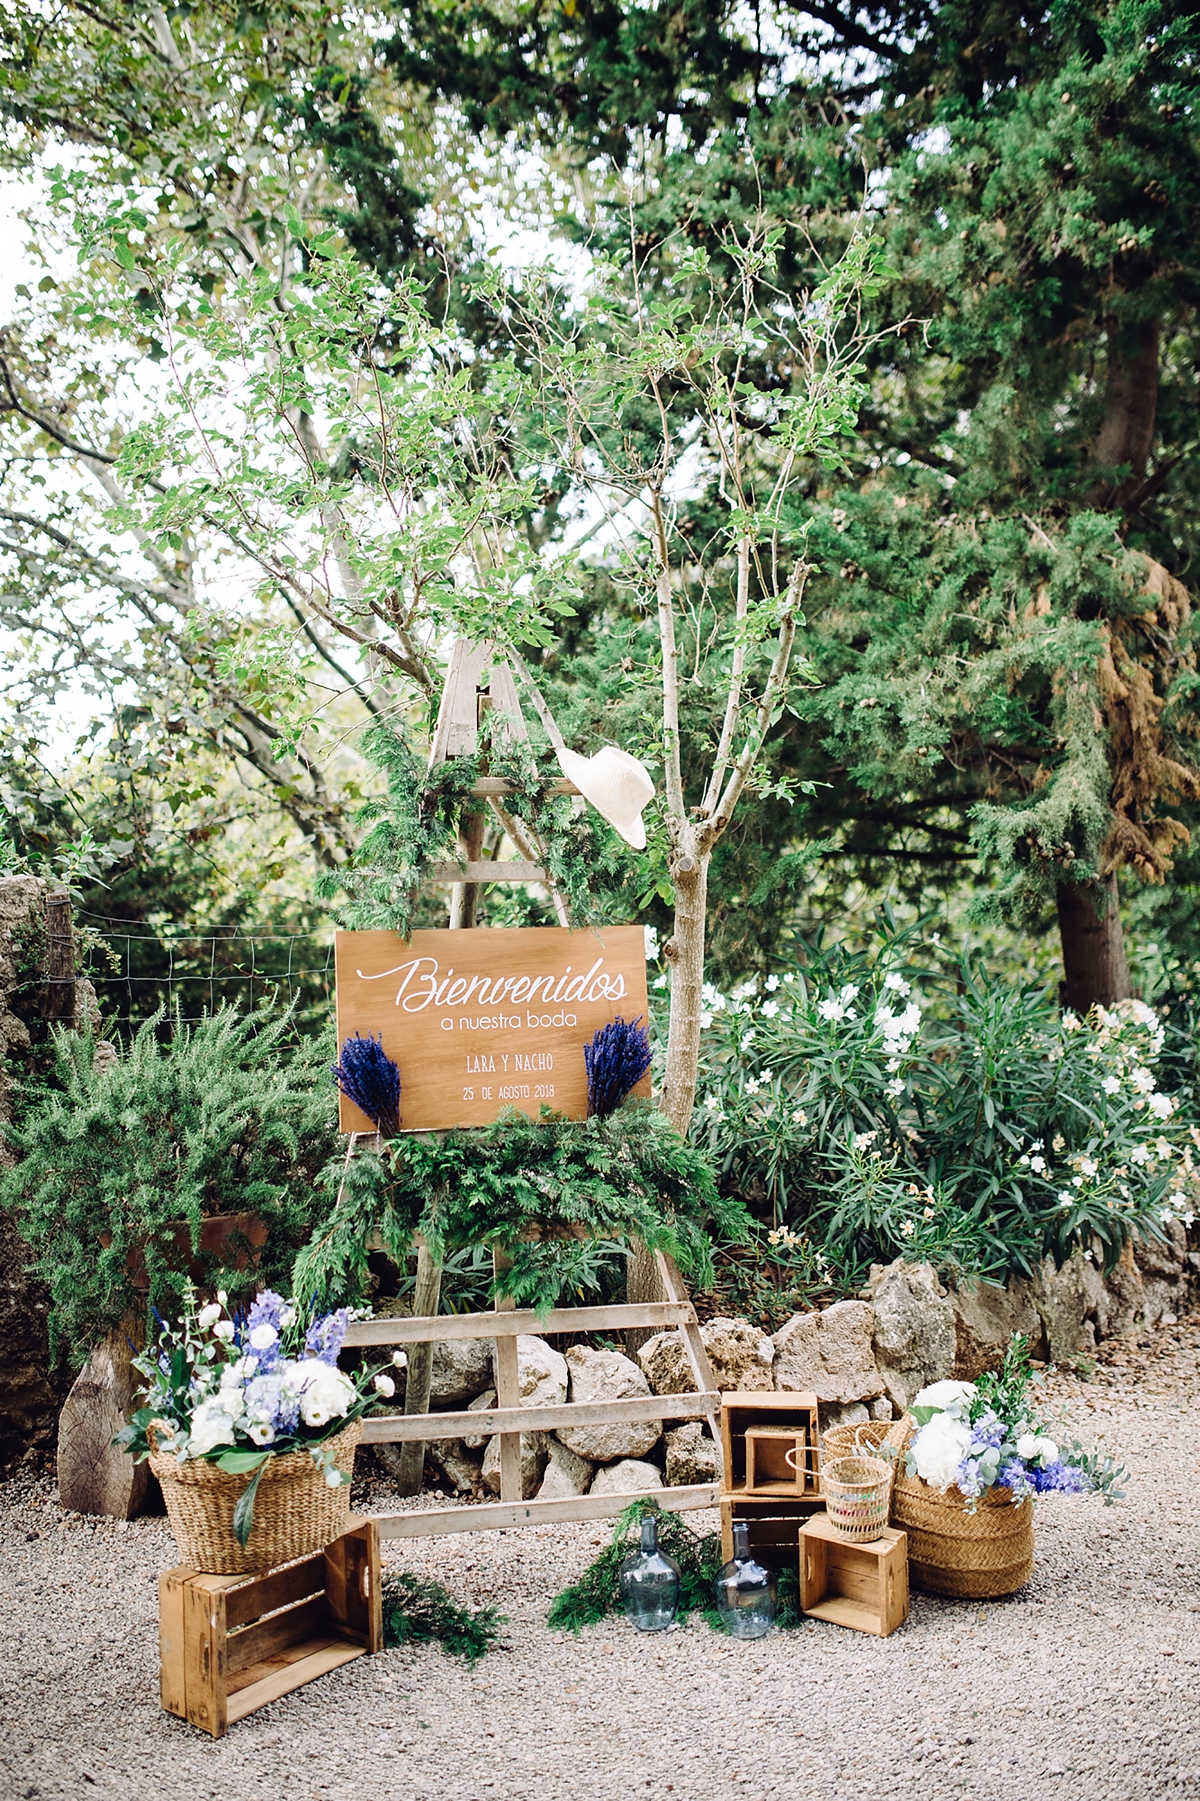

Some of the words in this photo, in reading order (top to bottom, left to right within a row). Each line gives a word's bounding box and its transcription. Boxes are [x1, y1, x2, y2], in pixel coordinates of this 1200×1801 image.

[356, 957, 628, 1012] Bienvenidos
[440, 1017, 454, 1031] a
[459, 1013, 522, 1030] nuestra
[527, 1009, 578, 1028] boda
[466, 1055, 496, 1074] LARA
[502, 1055, 510, 1072] Y
[515, 1053, 553, 1071] NACHO
[463, 1087, 474, 1100] 25
[482, 1086, 493, 1100] DE
[498, 1085, 530, 1099] AGOSTO
[534, 1084, 555, 1098] 2018
